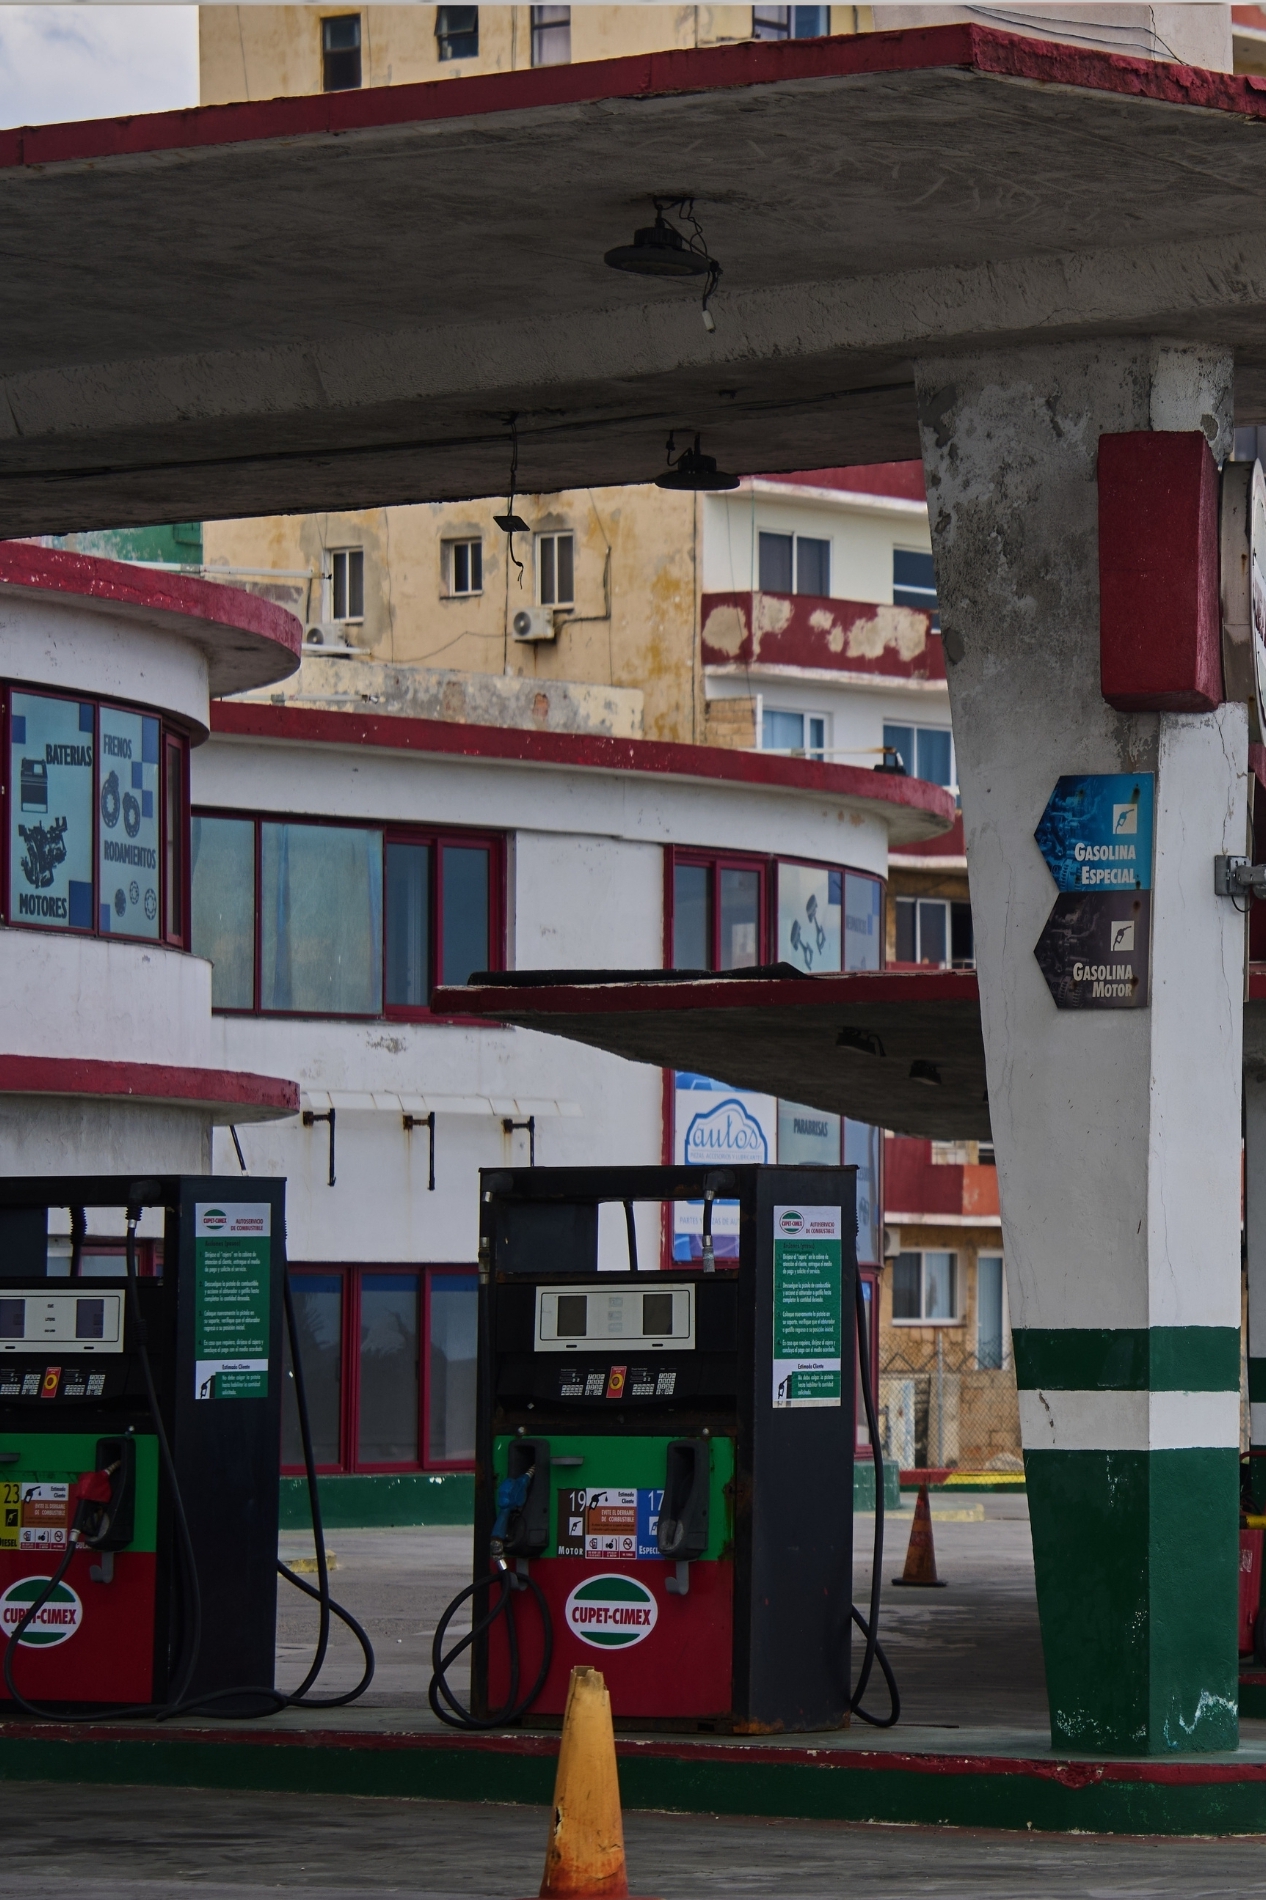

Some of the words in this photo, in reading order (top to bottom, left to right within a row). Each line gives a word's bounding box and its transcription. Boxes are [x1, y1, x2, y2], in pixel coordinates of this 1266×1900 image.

[46, 743, 93, 767] BATERIAS
[103, 733, 133, 760] FRENOS
[103, 840, 156, 870] RODAMIENTOS
[1074, 842, 1136, 861] GASOLINA
[1081, 866, 1136, 884] ESPECIAL
[19, 893, 67, 919] MOTORES
[1072, 962, 1133, 980] GASOLINA
[1092, 981, 1132, 998] MOTOR
[693, 1114, 761, 1150] autos
[793, 1118, 828, 1137] PARABRISAS
[4, 1484, 20, 1504] 23
[570, 1491, 586, 1512] 19
[648, 1490, 665, 1511] 17
[558, 1546, 583, 1555] MOTOR
[572, 1607, 651, 1625] CUPET-CIMEX
